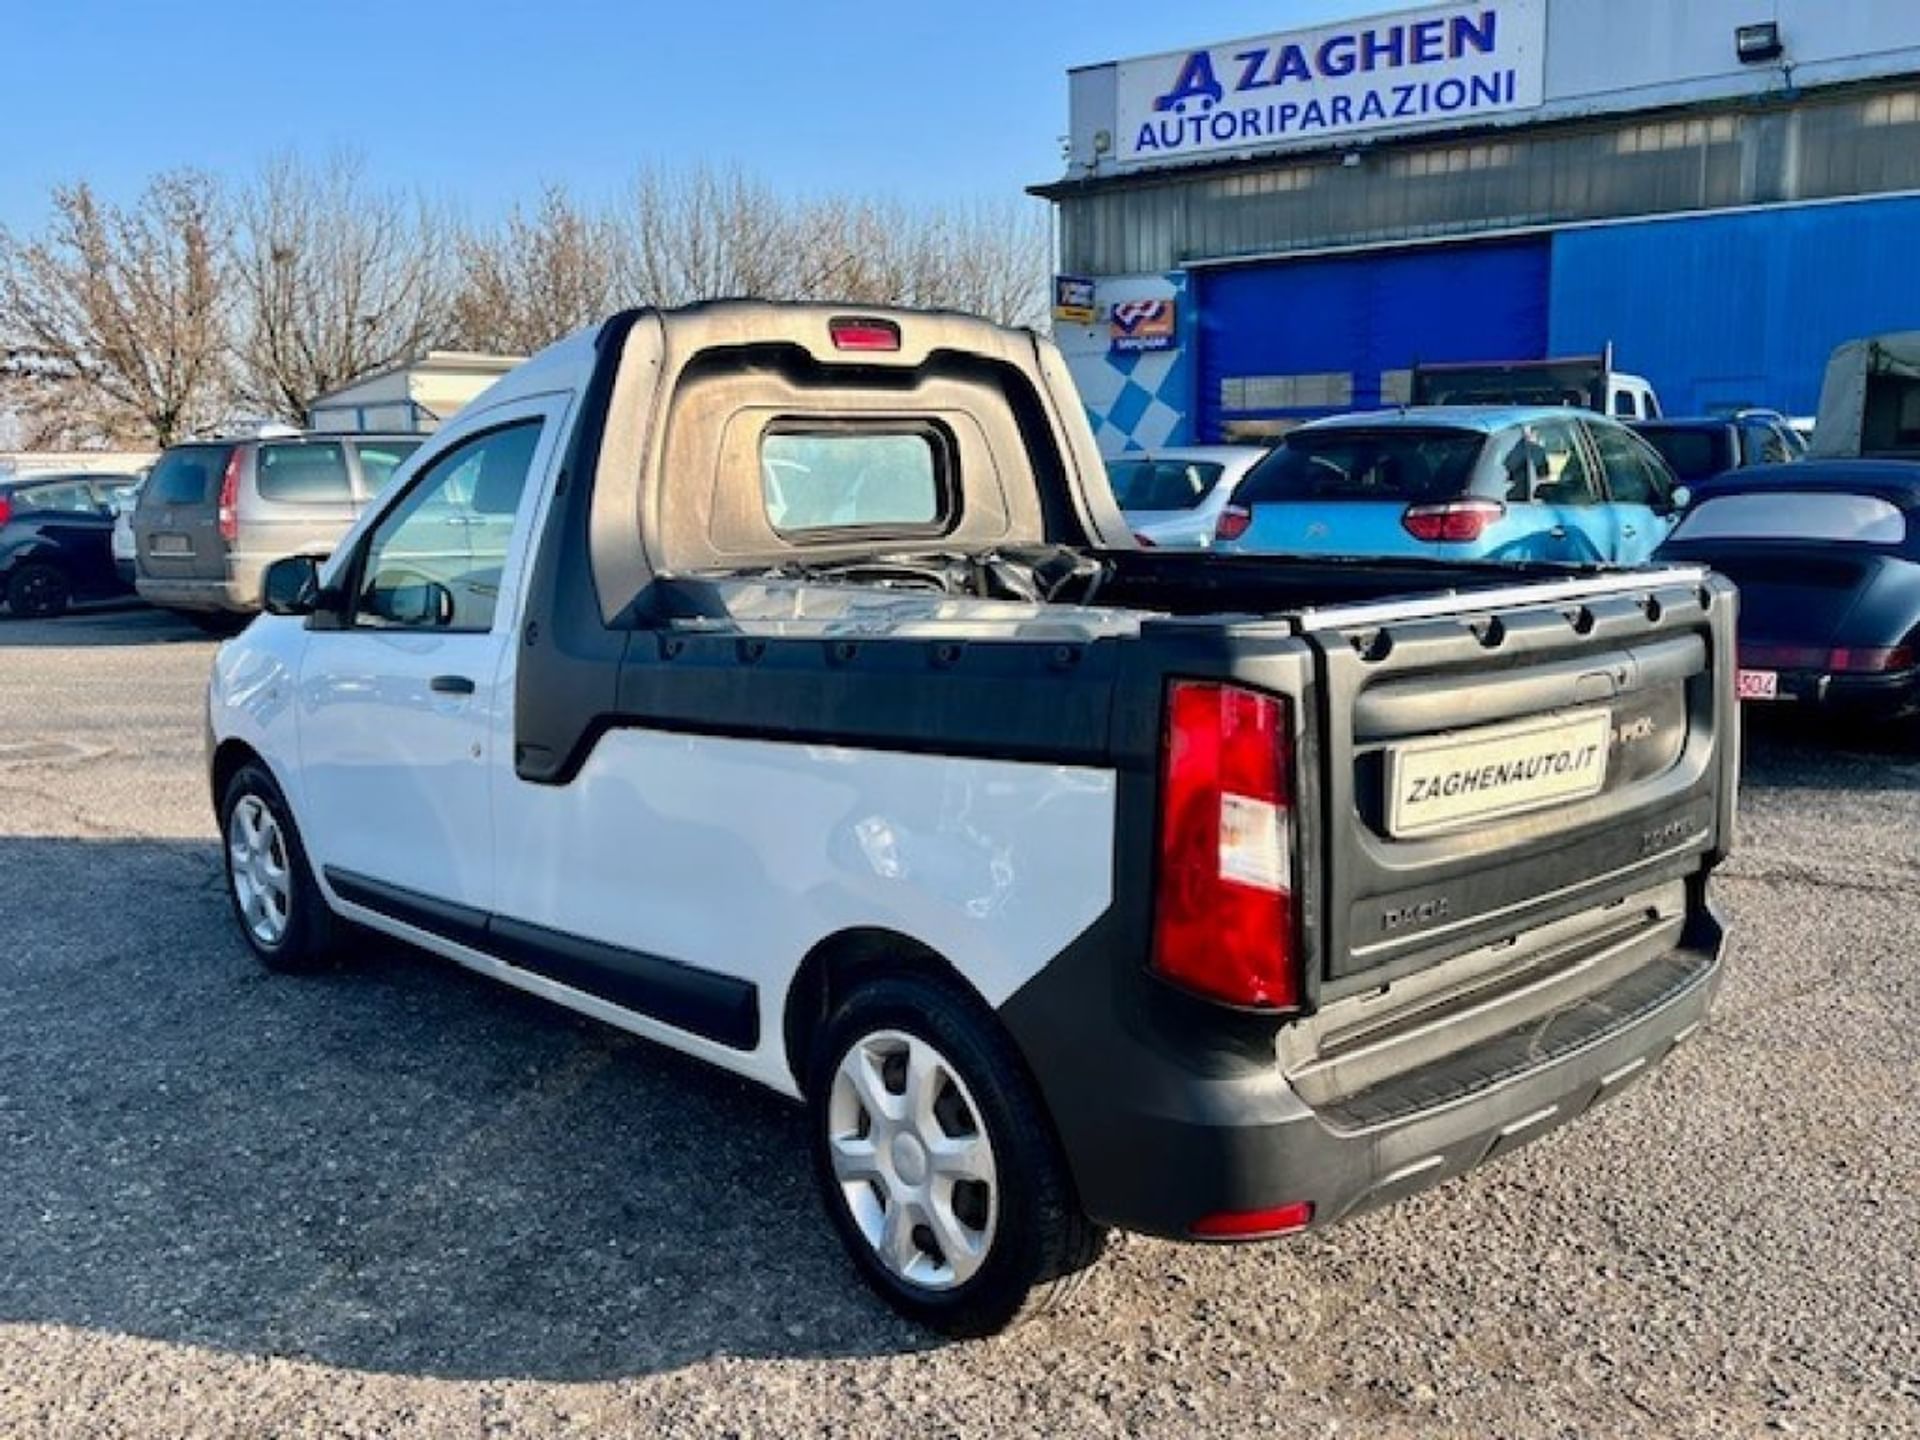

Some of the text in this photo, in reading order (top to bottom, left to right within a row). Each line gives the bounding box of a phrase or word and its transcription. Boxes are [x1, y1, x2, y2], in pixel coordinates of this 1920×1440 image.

[1234, 10, 1496, 91] ZAGHEN
[1136, 70, 1516, 152] AUTORIPARAZIONI
[1406, 745, 1597, 804] ZAGHENAUTO.IT
